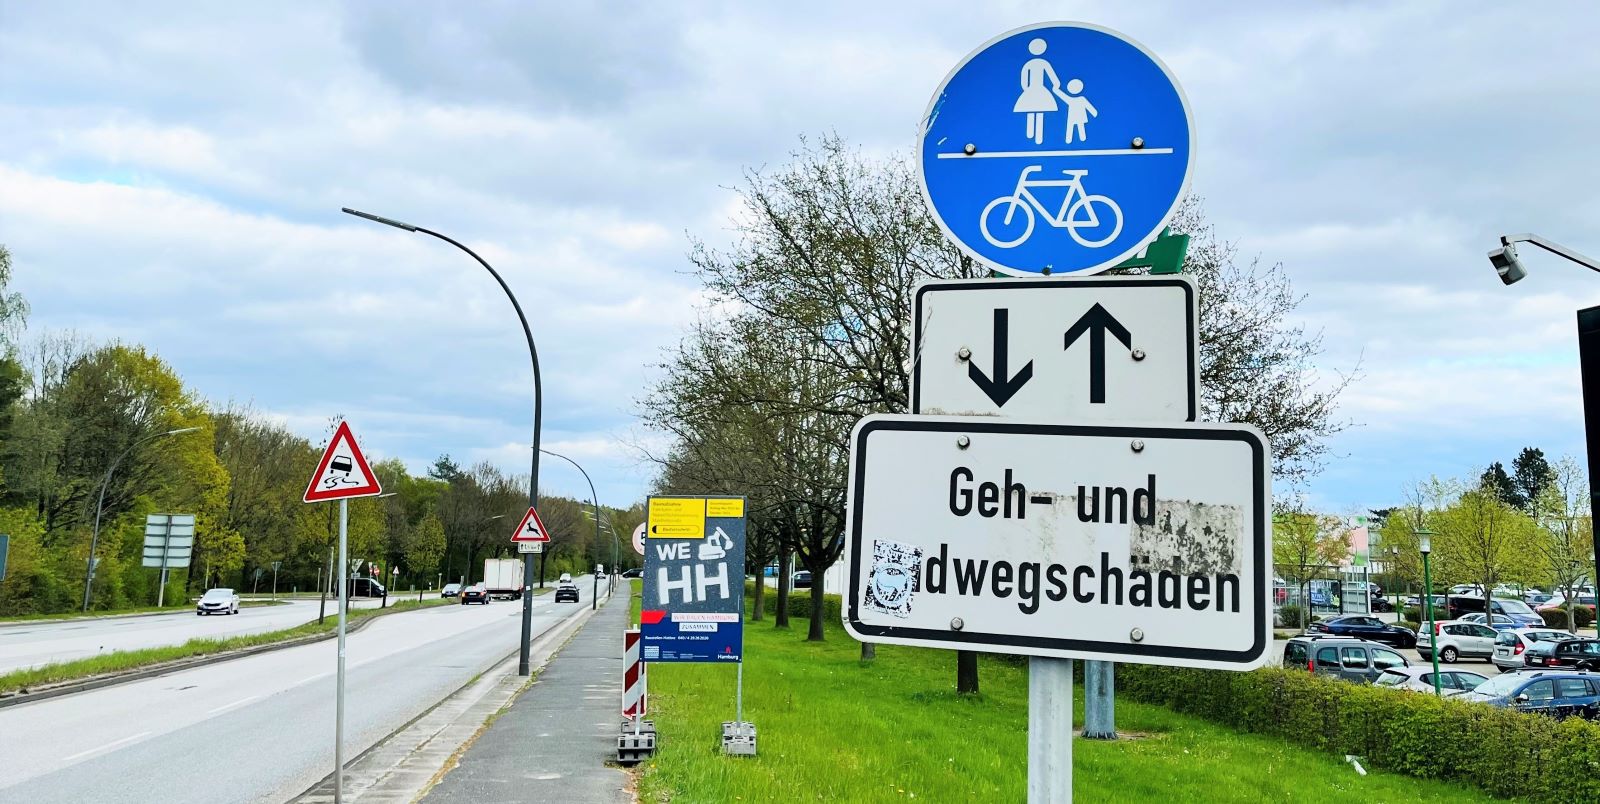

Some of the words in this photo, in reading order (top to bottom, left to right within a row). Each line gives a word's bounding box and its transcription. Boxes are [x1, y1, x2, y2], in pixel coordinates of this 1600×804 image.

[949, 466, 1053, 519] Geh-
[1077, 473, 1156, 526] und
[656, 542, 692, 561] WE
[657, 562, 730, 605] HH
[911, 543, 1241, 615] dwegschäden
[717, 653, 739, 661] Hamburg
